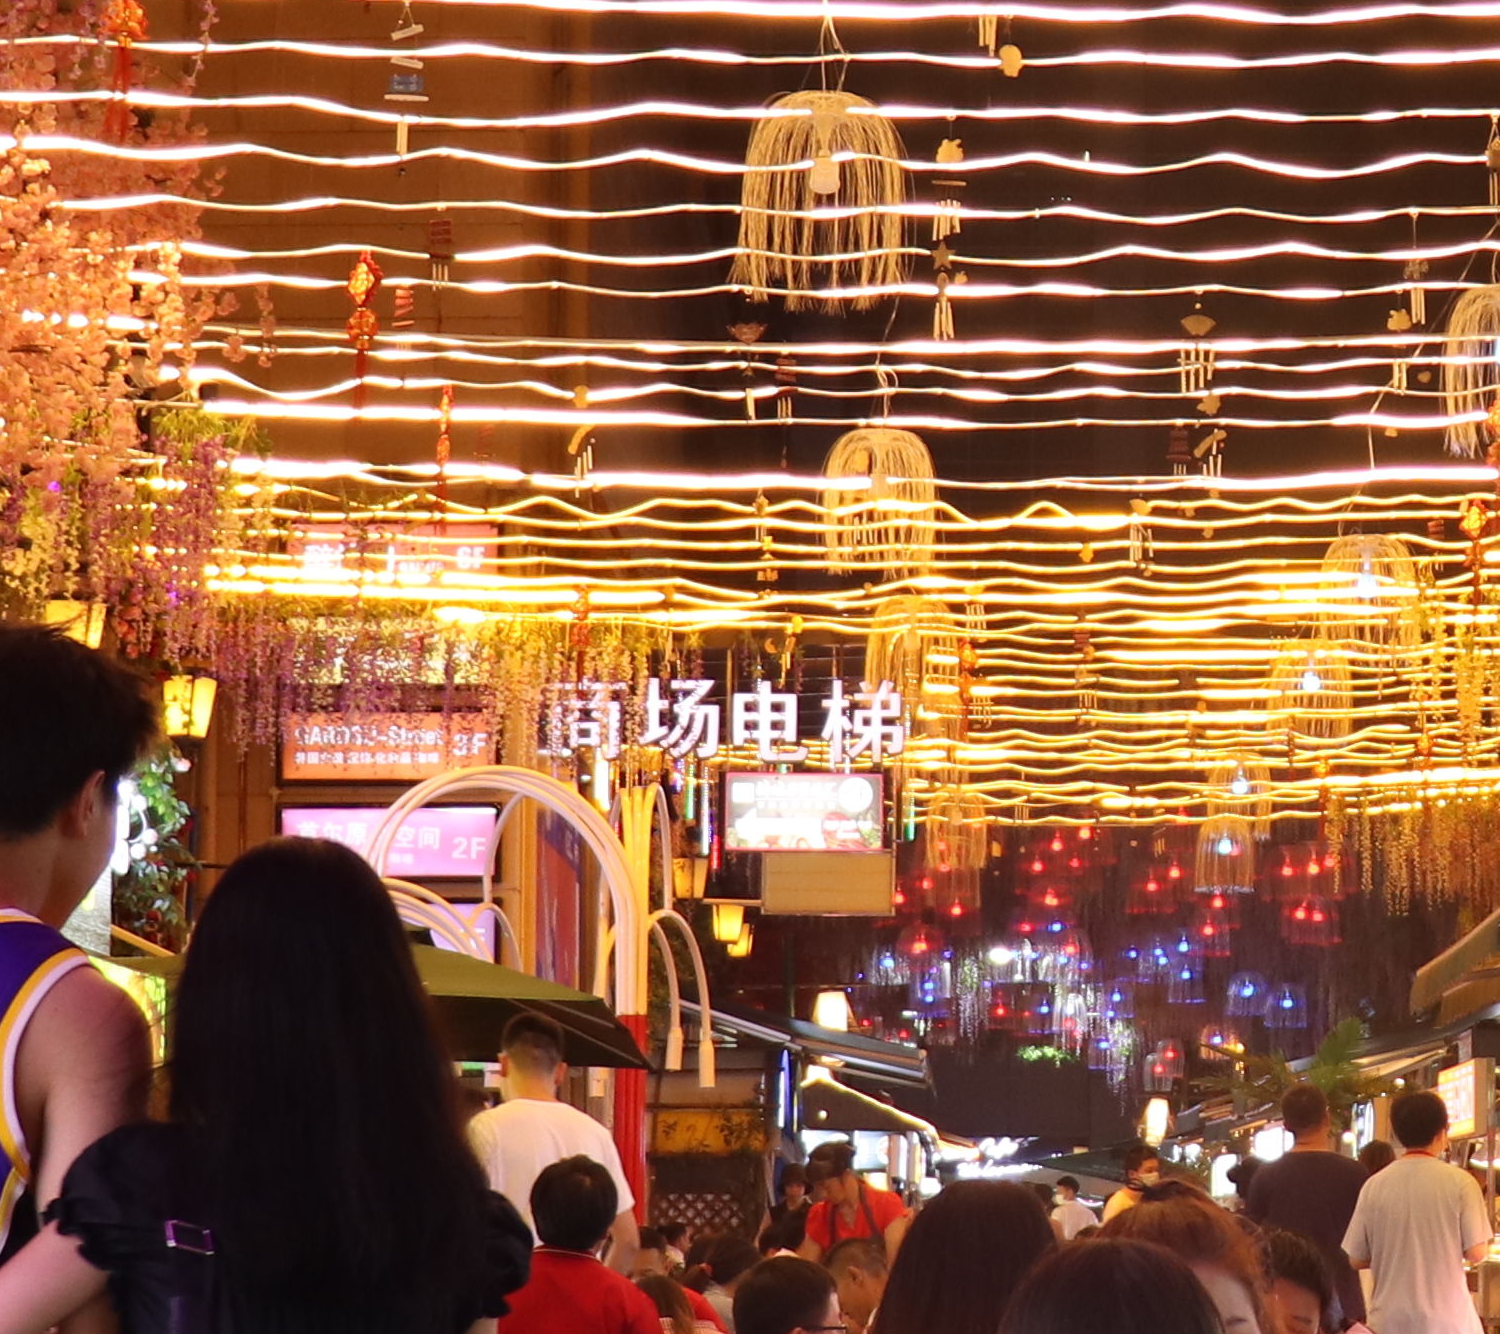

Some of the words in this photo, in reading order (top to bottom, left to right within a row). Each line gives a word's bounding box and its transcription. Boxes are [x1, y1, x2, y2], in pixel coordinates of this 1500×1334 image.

[549, 677, 906, 769] 商场电梯
[297, 821, 441, 851] 首尔原空间
[451, 836, 487, 860] 2F
